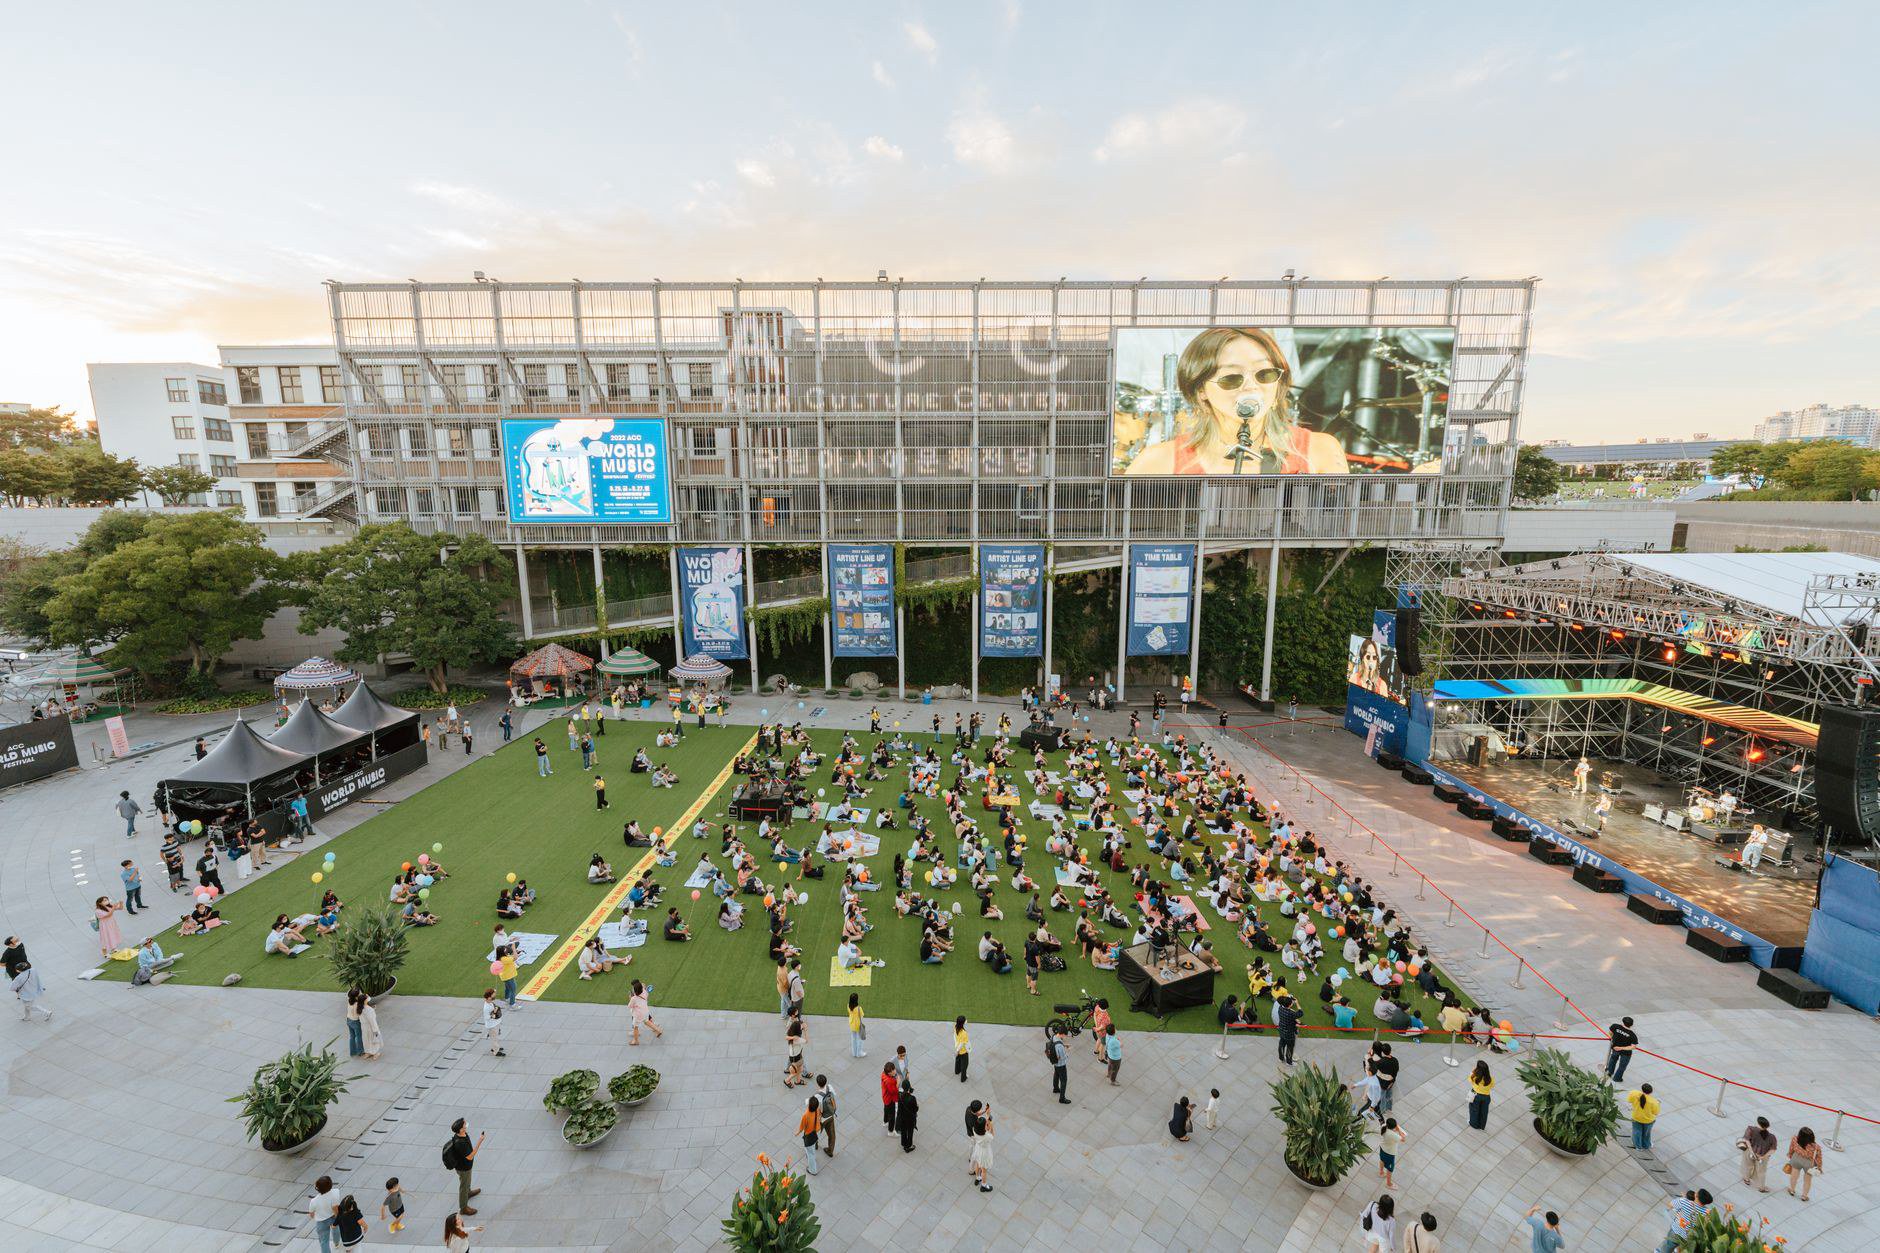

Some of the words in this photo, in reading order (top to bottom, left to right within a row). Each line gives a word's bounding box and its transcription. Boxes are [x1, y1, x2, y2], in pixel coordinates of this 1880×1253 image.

[601, 443, 656, 458] WORLD
[602, 458, 655, 473] MUSIC
[836, 554, 859, 562] ARTIST
[861, 554, 875, 562] LINE
[876, 554, 886, 562] UP
[988, 554, 1010, 562] ARTIST
[1012, 554, 1026, 562] LINE
[1027, 554, 1037, 562] UP
[1144, 553, 1160, 561] TIME
[1162, 553, 1182, 561] TABLE
[1353, 705, 1373, 723] WORLD
[1373, 715, 1395, 733] MUSIC
[7, 743, 25, 752] ACC
[21, 740, 56, 758] MUSIC
[3, 756, 35, 769] FESTIVAL
[320, 782, 356, 806] WORLD
[357, 767, 386, 789] MUSIC
